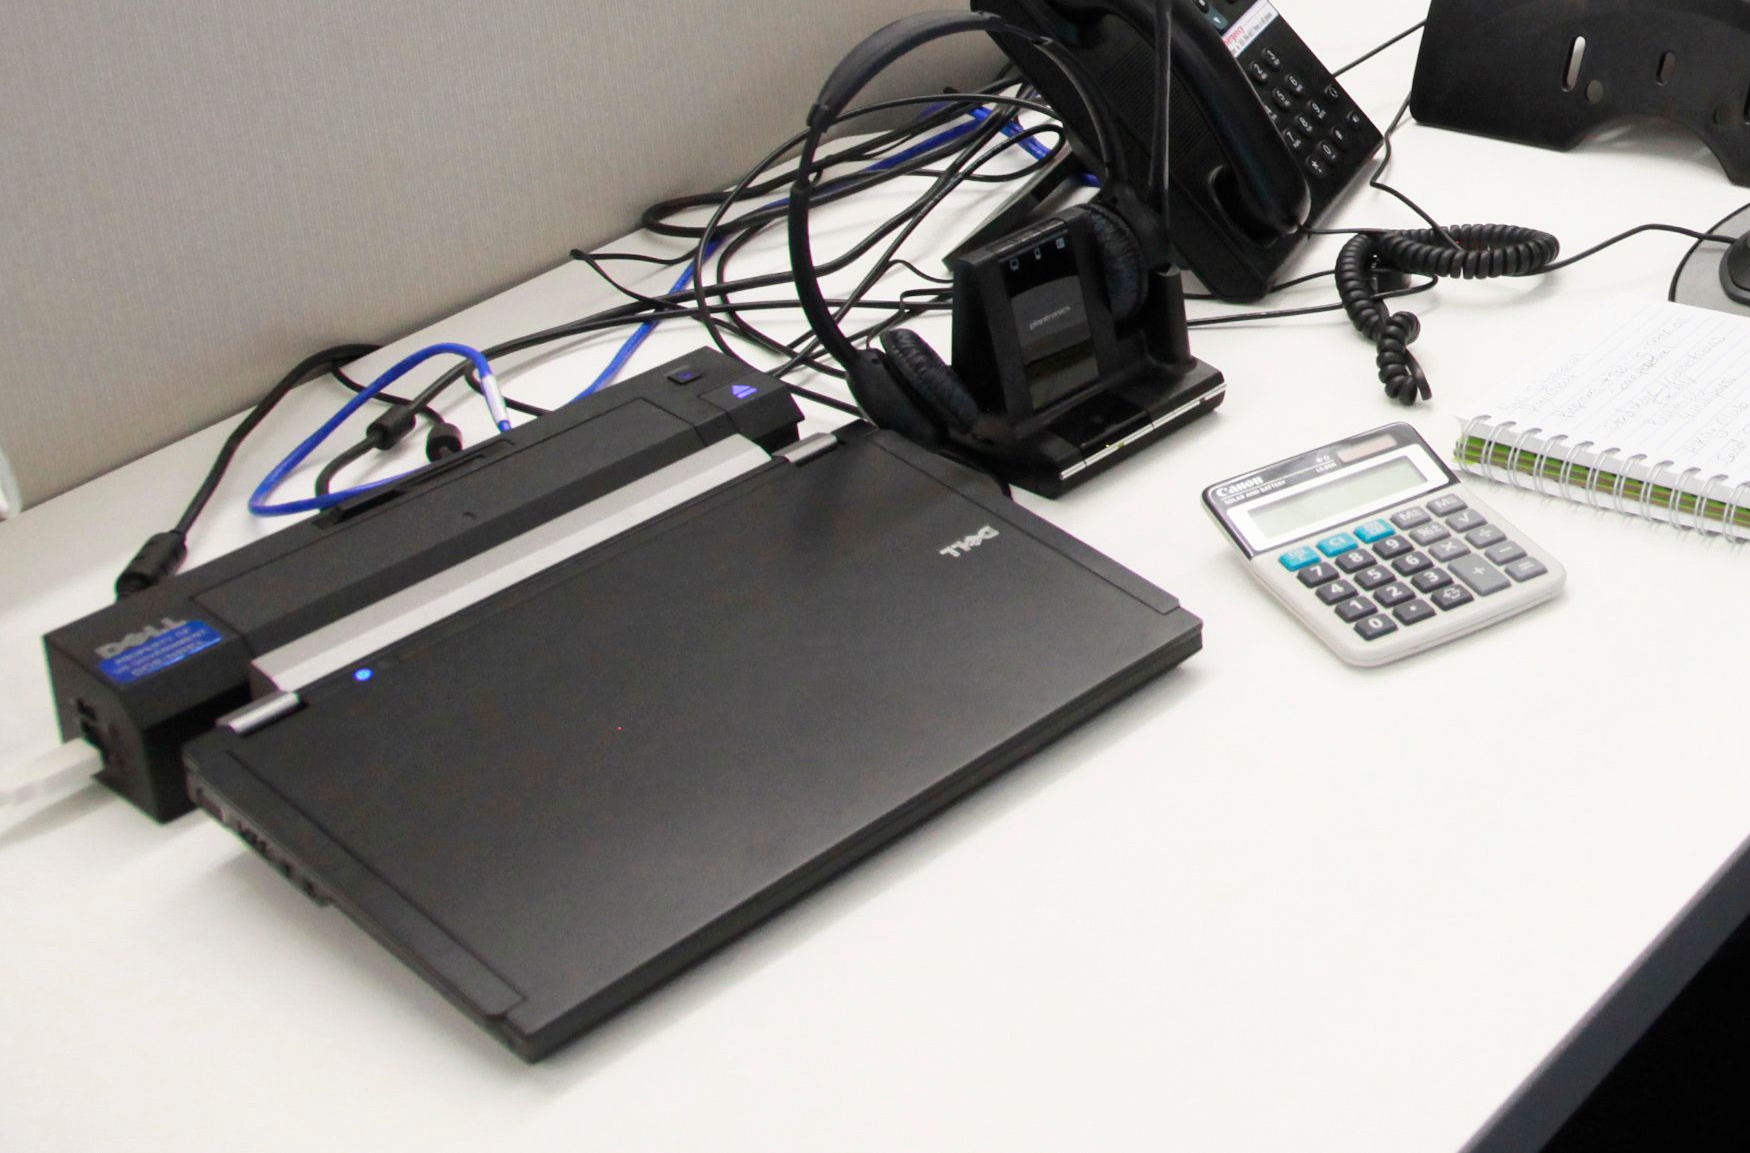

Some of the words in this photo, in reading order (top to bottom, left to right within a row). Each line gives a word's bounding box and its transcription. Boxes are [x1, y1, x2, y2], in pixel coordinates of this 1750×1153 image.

[1215, 476, 1264, 497] Canon
[1223, 493, 1245, 505] SOLAR
[1245, 488, 1260, 498] AND
[1261, 479, 1287, 494] BATTERY
[939, 525, 1000, 558] DELL
[1309, 565, 1323, 577] 7
[1348, 552, 1364, 563] 8
[1385, 538, 1400, 549] 9
[1330, 582, 1344, 593] 4
[1366, 568, 1382, 580] 5
[1405, 554, 1420, 566] 6
[1349, 599, 1364, 610] 1
[1385, 586, 1403, 598] 2
[1423, 571, 1439, 583] 3
[94, 617, 189, 659] DELL
[1368, 617, 1383, 629] 0
